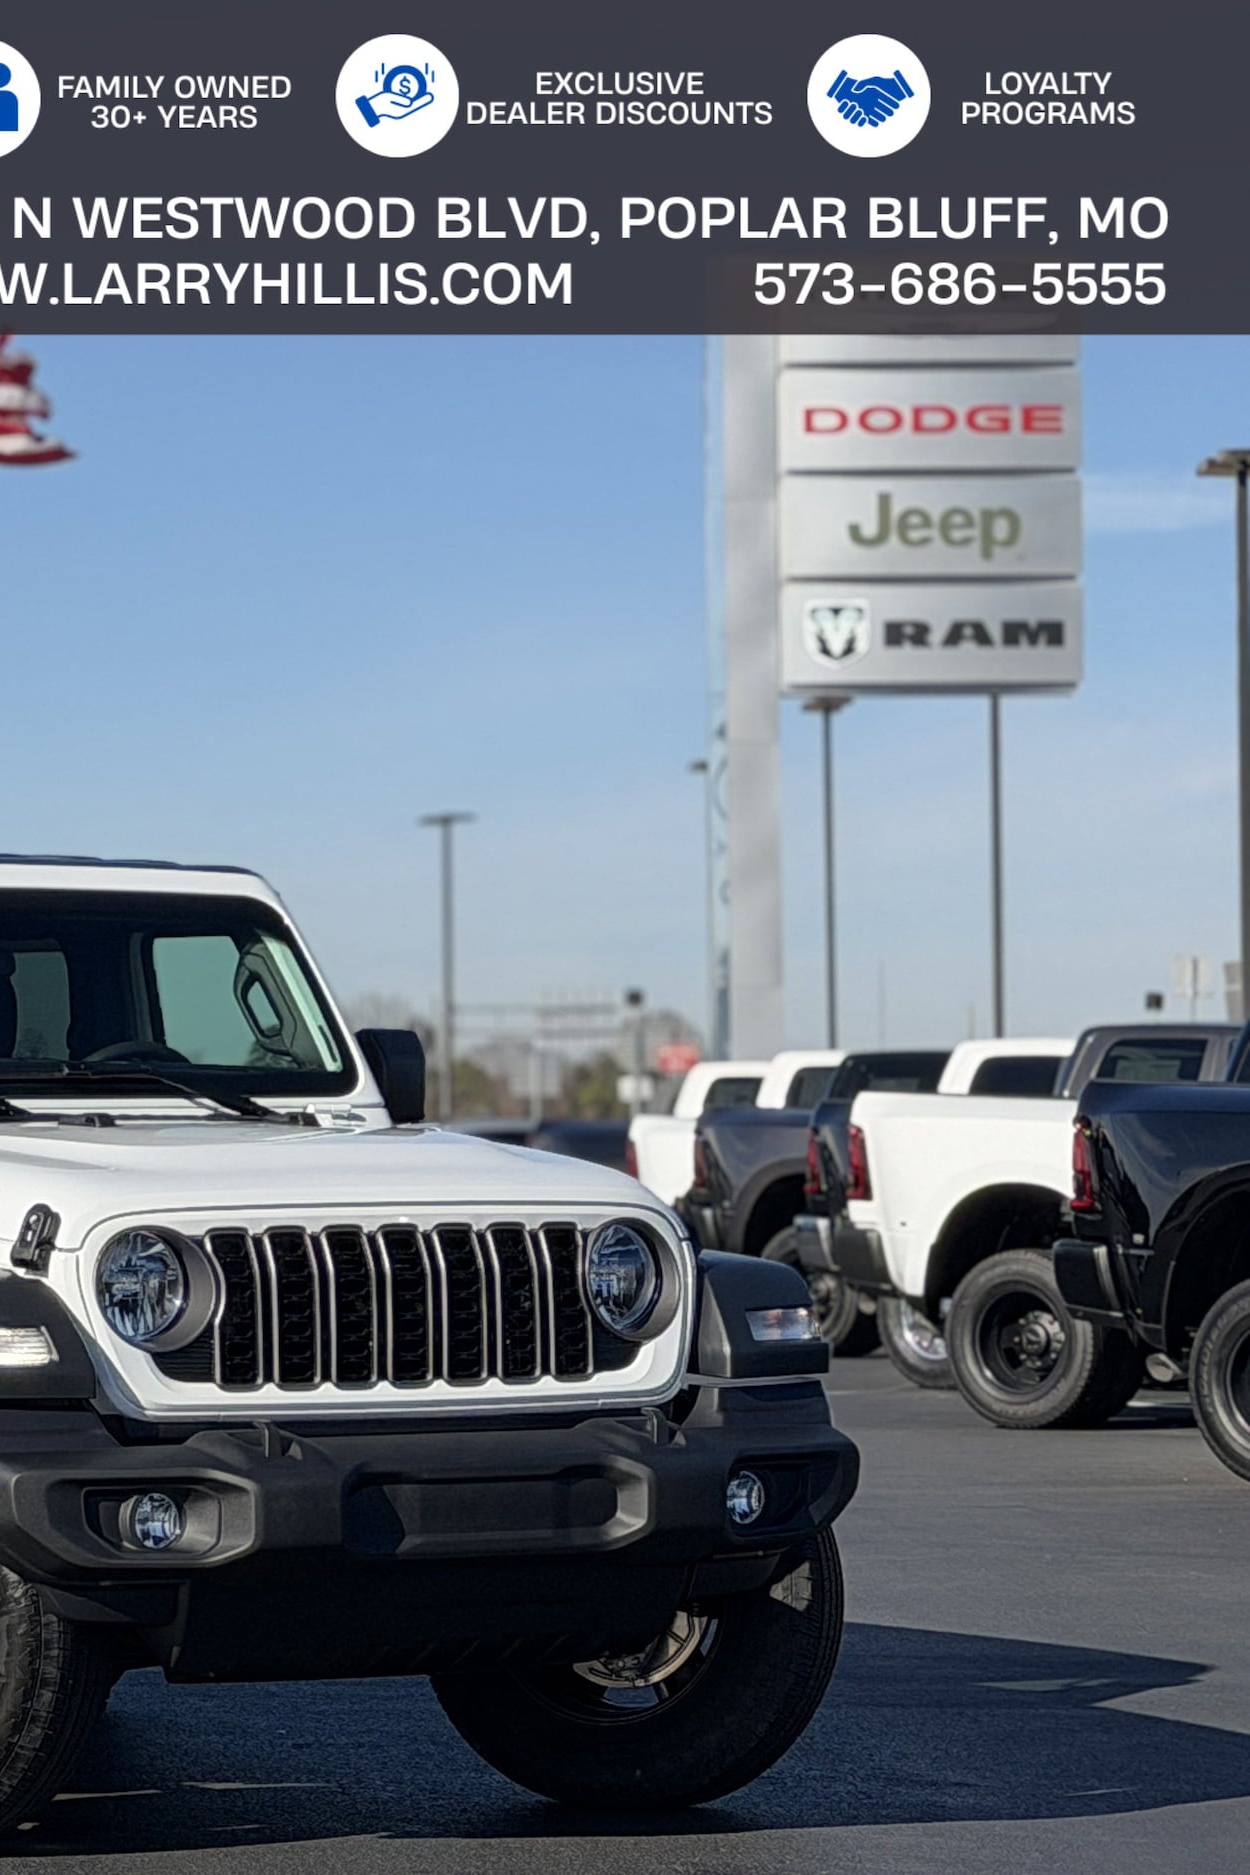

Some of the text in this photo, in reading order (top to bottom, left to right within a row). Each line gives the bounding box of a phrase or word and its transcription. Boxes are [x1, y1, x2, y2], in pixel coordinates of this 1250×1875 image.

[803, 404, 1064, 434] DODGE
[847, 493, 1022, 560] Jeep
[883, 620, 1065, 648] RAM
